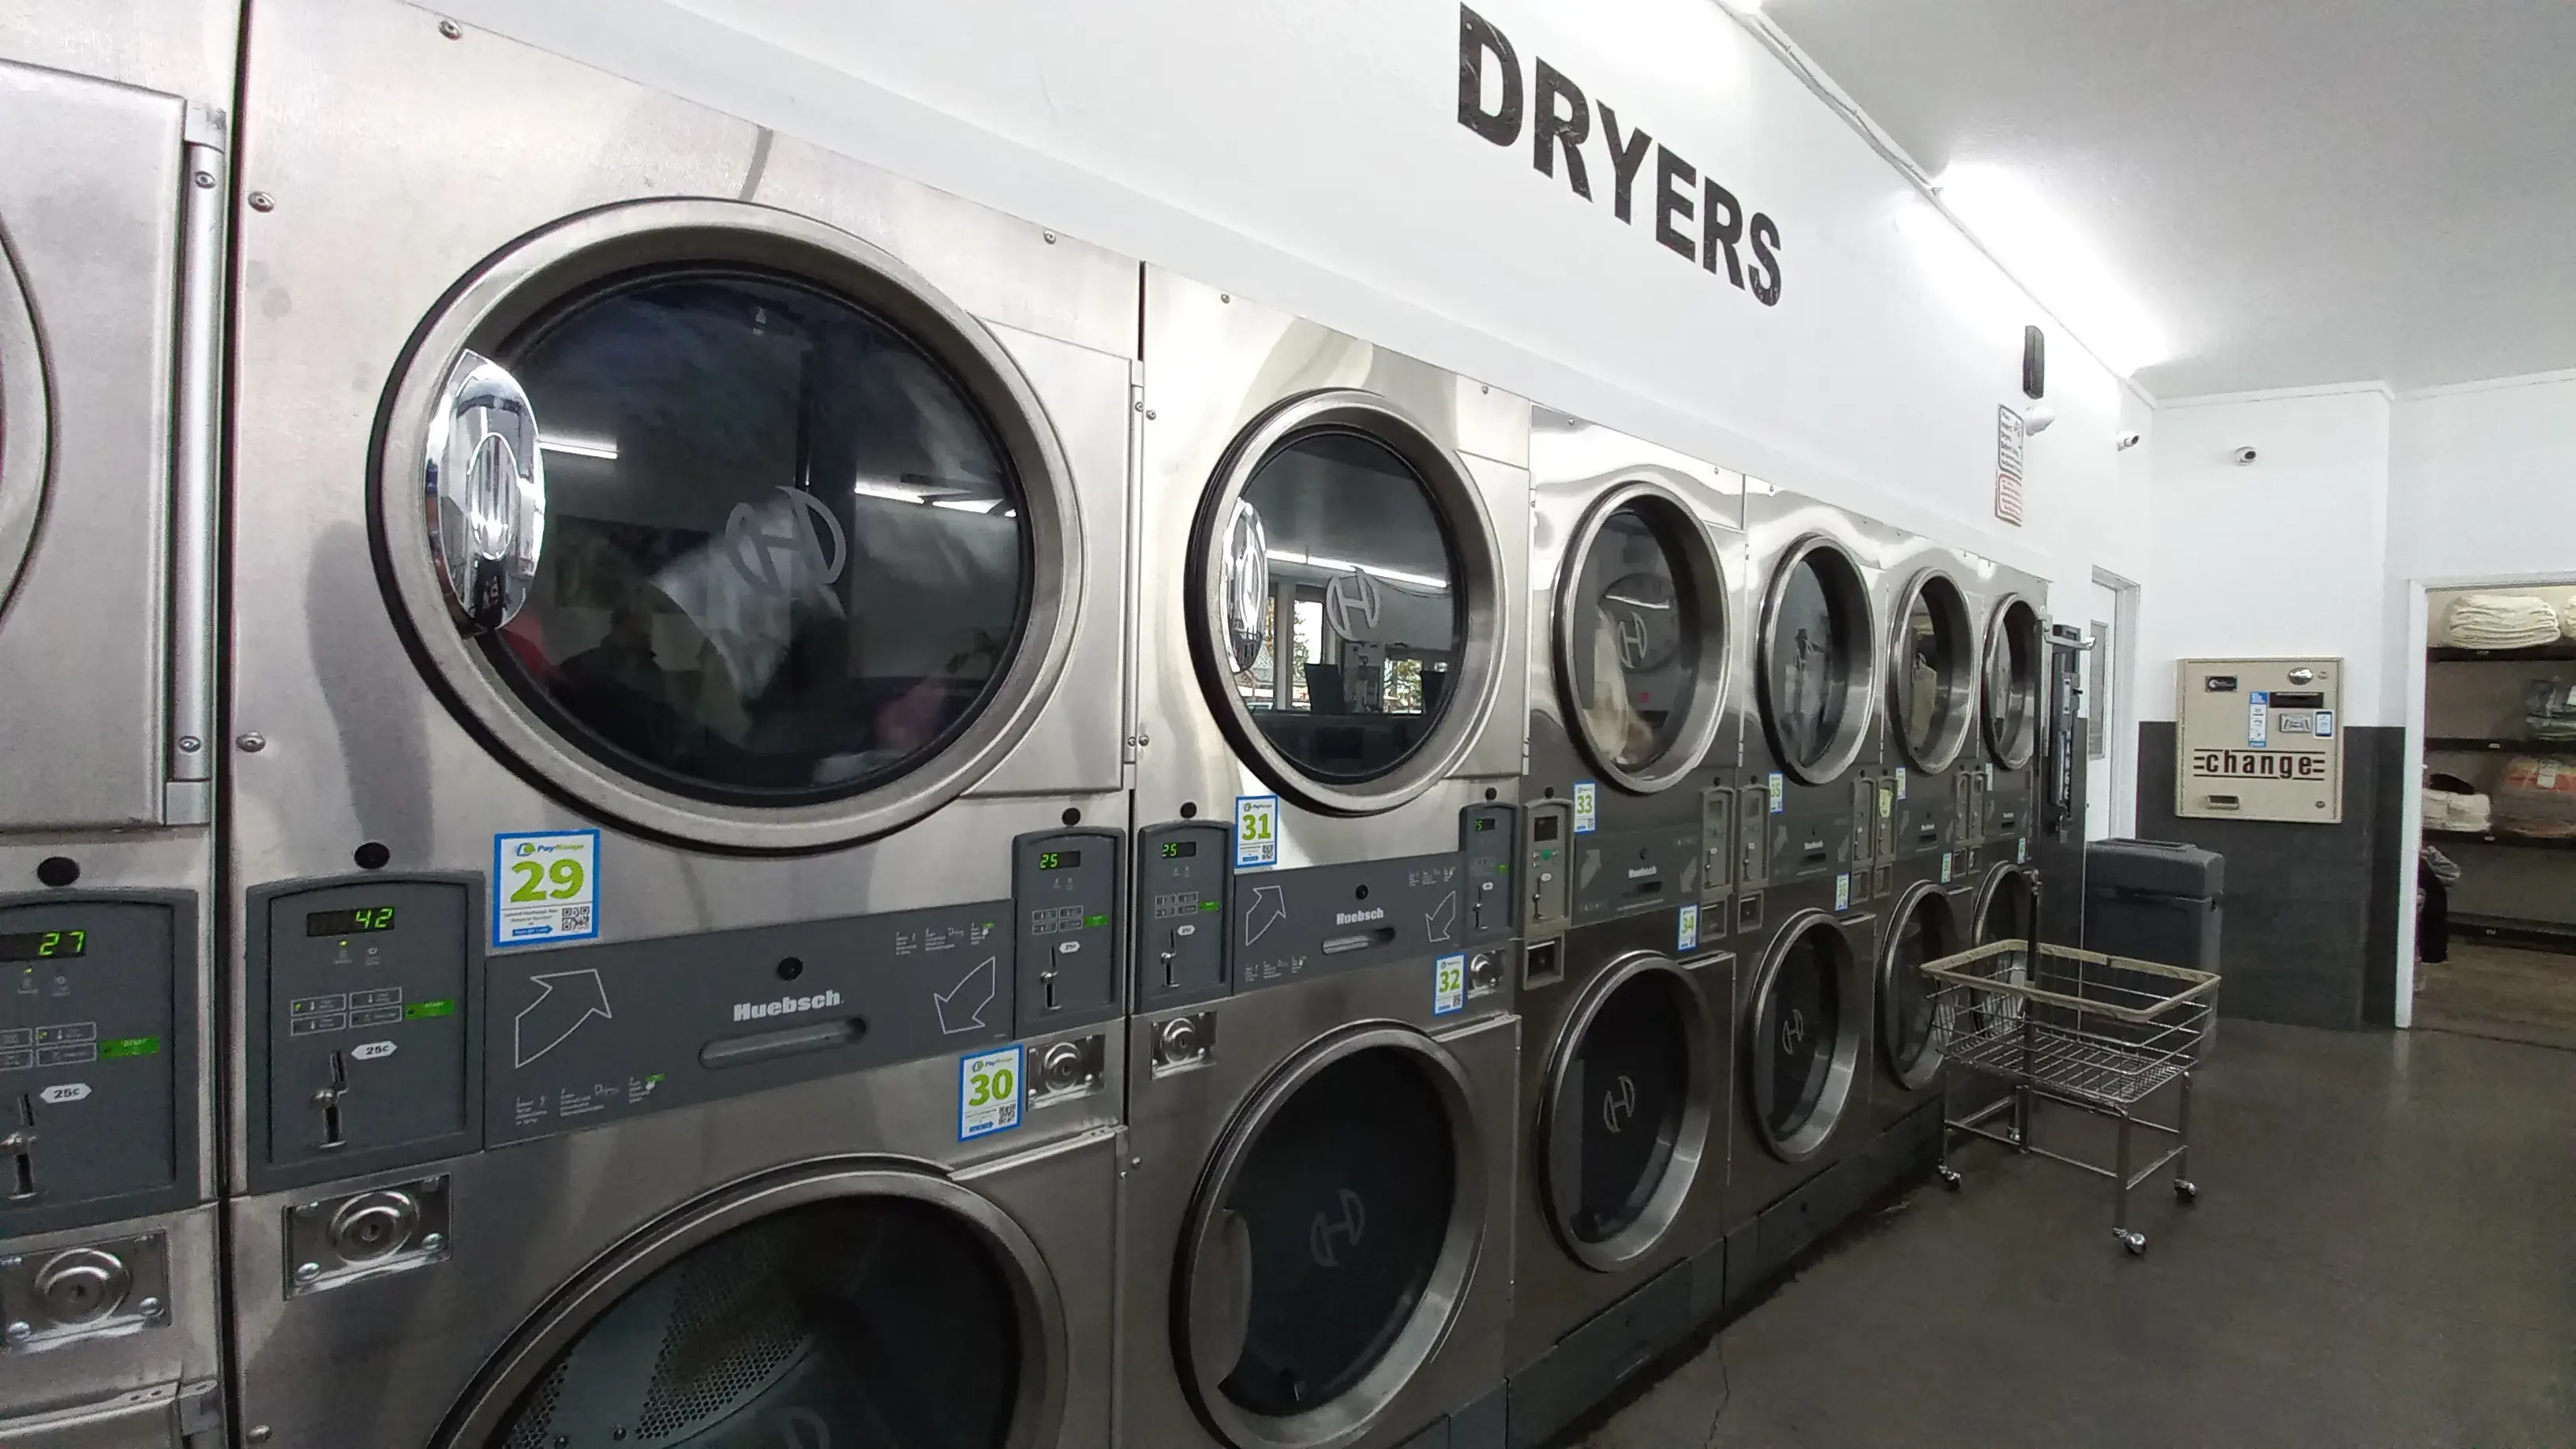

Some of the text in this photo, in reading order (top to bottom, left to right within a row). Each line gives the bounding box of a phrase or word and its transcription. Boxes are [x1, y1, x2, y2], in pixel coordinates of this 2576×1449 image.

[1458, 2, 1782, 306] DRYERS
[2206, 750, 2312, 779] change
[1577, 794, 1593, 814] 33
[1241, 813, 1271, 841] 31
[1039, 853, 1058, 869] 25
[511, 859, 584, 903] 29
[355, 908, 393, 929] 42
[39, 930, 84, 956] 27
[1440, 968, 1461, 993] 32
[733, 989, 841, 1022] Huebsch
[968, 1068, 1013, 1106] 30
